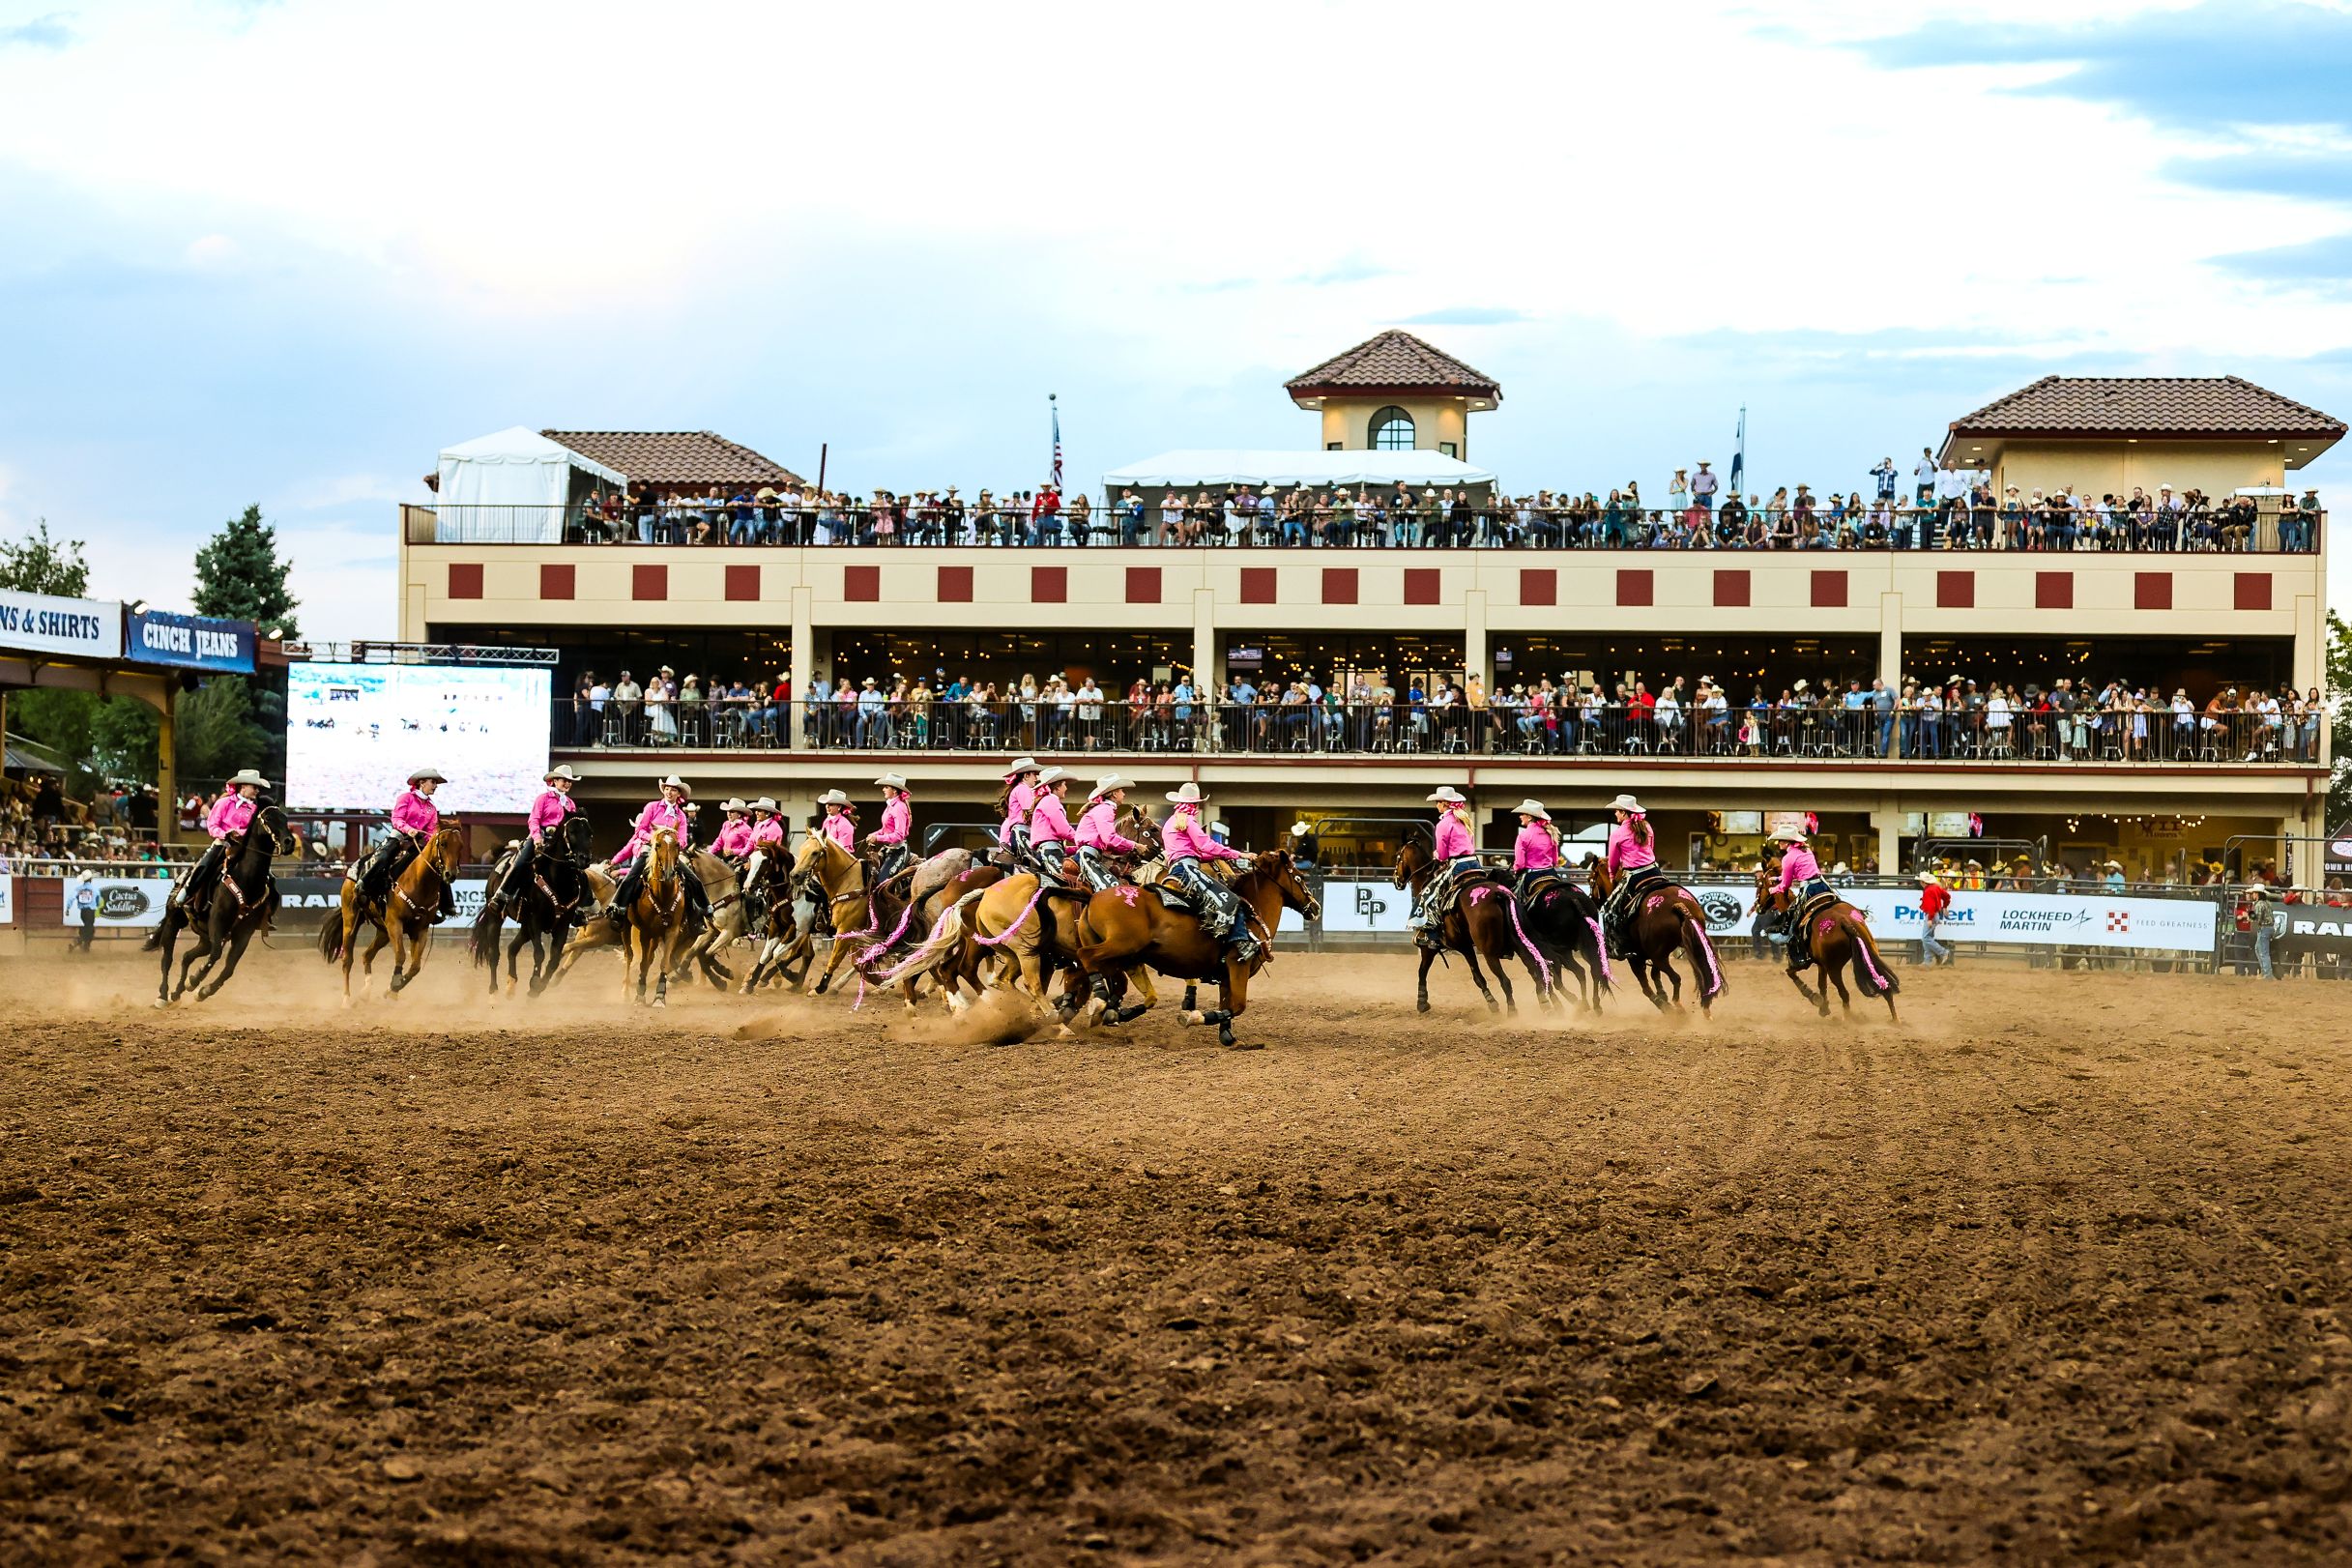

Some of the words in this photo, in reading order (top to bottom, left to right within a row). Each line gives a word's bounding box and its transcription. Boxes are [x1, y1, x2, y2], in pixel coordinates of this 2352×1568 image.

[22, 608, 35, 633] &
[39, 610, 100, 641] SHIRTS
[143, 622, 190, 653] CINCH
[195, 629, 238, 659] JEANS
[108, 889, 137, 902] Cactus
[1698, 892, 1739, 906] COWBOY
[1895, 906, 1974, 921] Prifert
[2002, 910, 2073, 921] LOCKHEED
[2000, 921, 2051, 931] MARTIN
